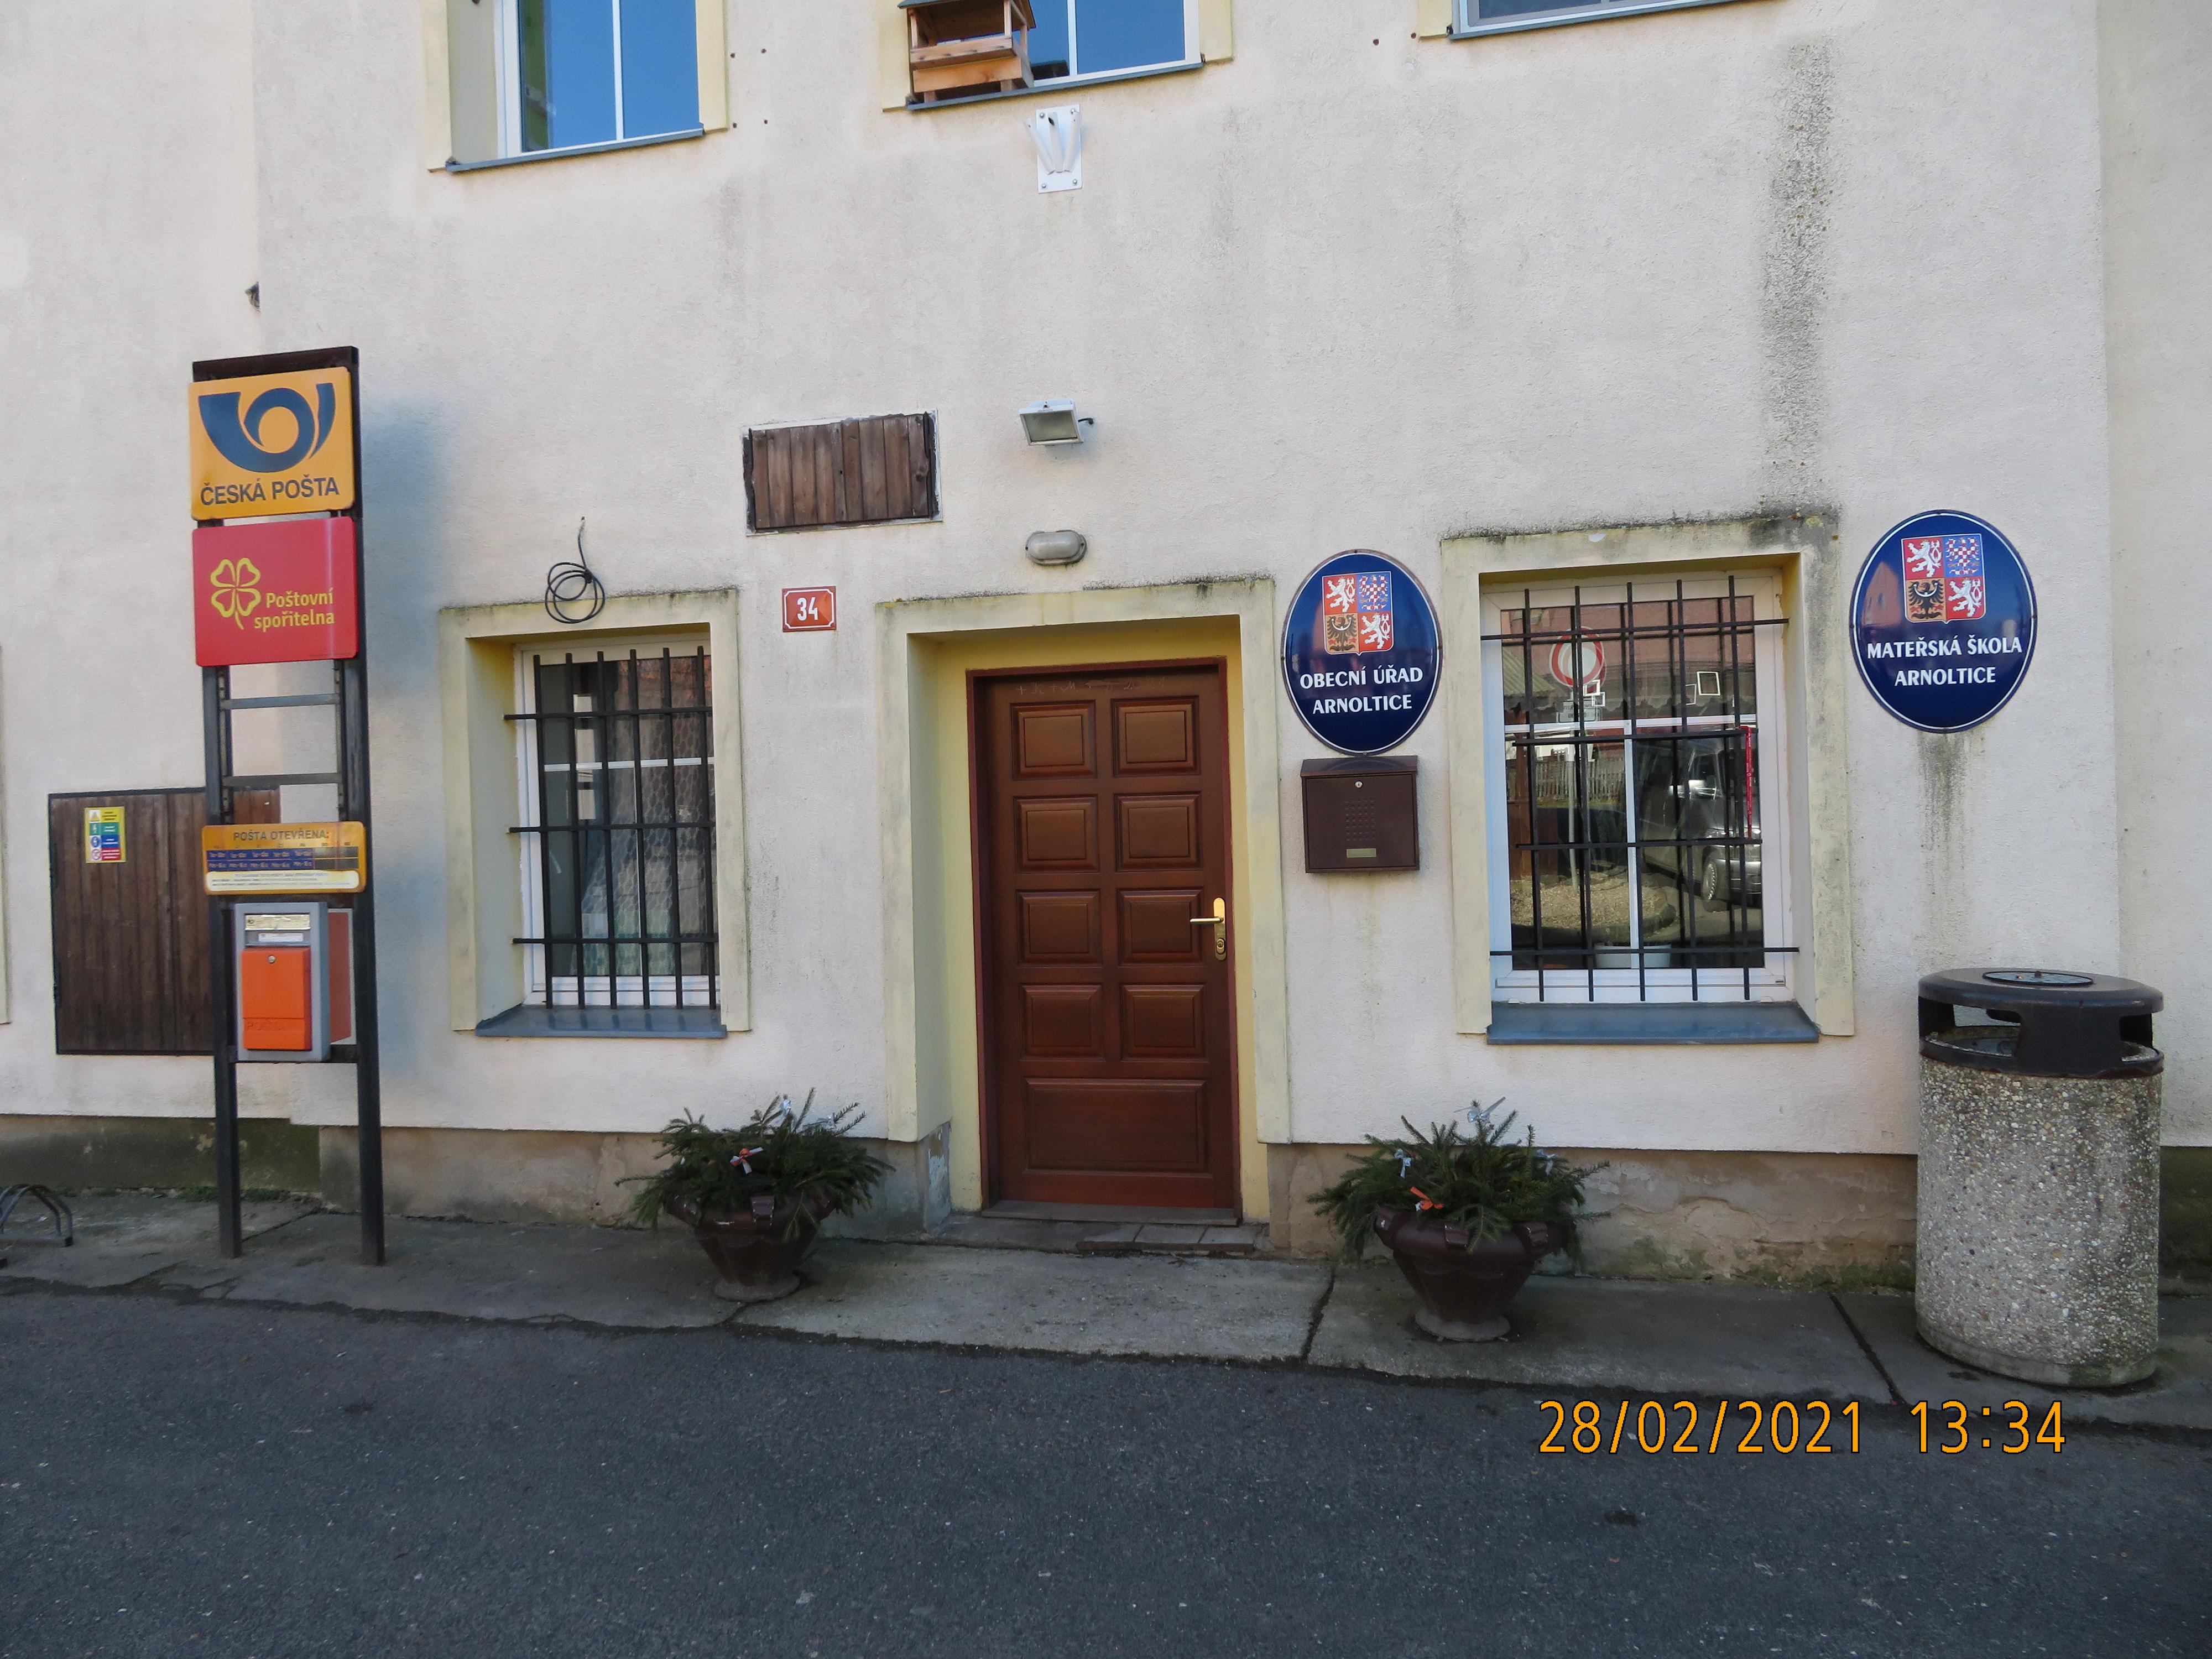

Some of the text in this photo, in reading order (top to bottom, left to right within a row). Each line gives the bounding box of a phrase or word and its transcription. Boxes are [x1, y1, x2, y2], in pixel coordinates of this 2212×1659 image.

[200, 473, 340, 506] ČESKÁ POŠTA
[265, 587, 333, 608] Poštovní
[797, 597, 818, 621] 34
[254, 609, 335, 633] spořitelna
[1867, 634, 2023, 659] MATEŘSKÁ ŠKOLA
[1300, 664, 1424, 690] OBECNÍ ÚŘAD
[1894, 666, 1996, 687] ARNOLTICE
[1312, 694, 1412, 714] ARNOLTICE
[233, 827, 330, 841] POŠTA OTEVŘENA:
